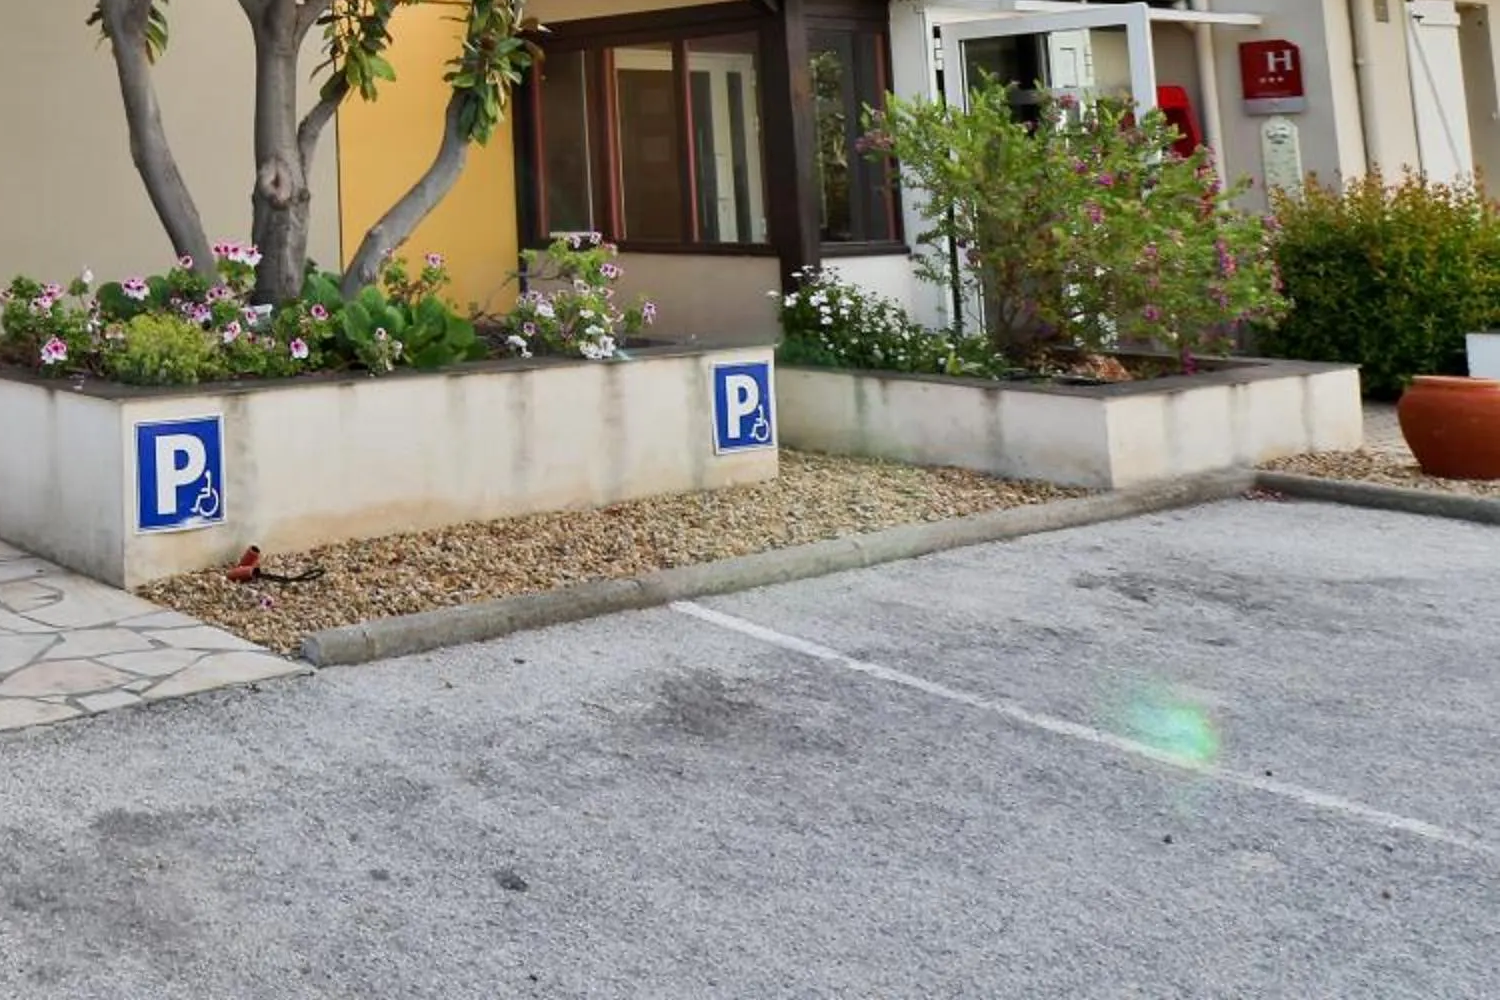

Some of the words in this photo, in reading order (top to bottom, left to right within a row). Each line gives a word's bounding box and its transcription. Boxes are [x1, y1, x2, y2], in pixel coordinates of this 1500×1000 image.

[1267, 49, 1293, 72] H
[725, 373, 759, 439] P
[155, 433, 206, 515] P
